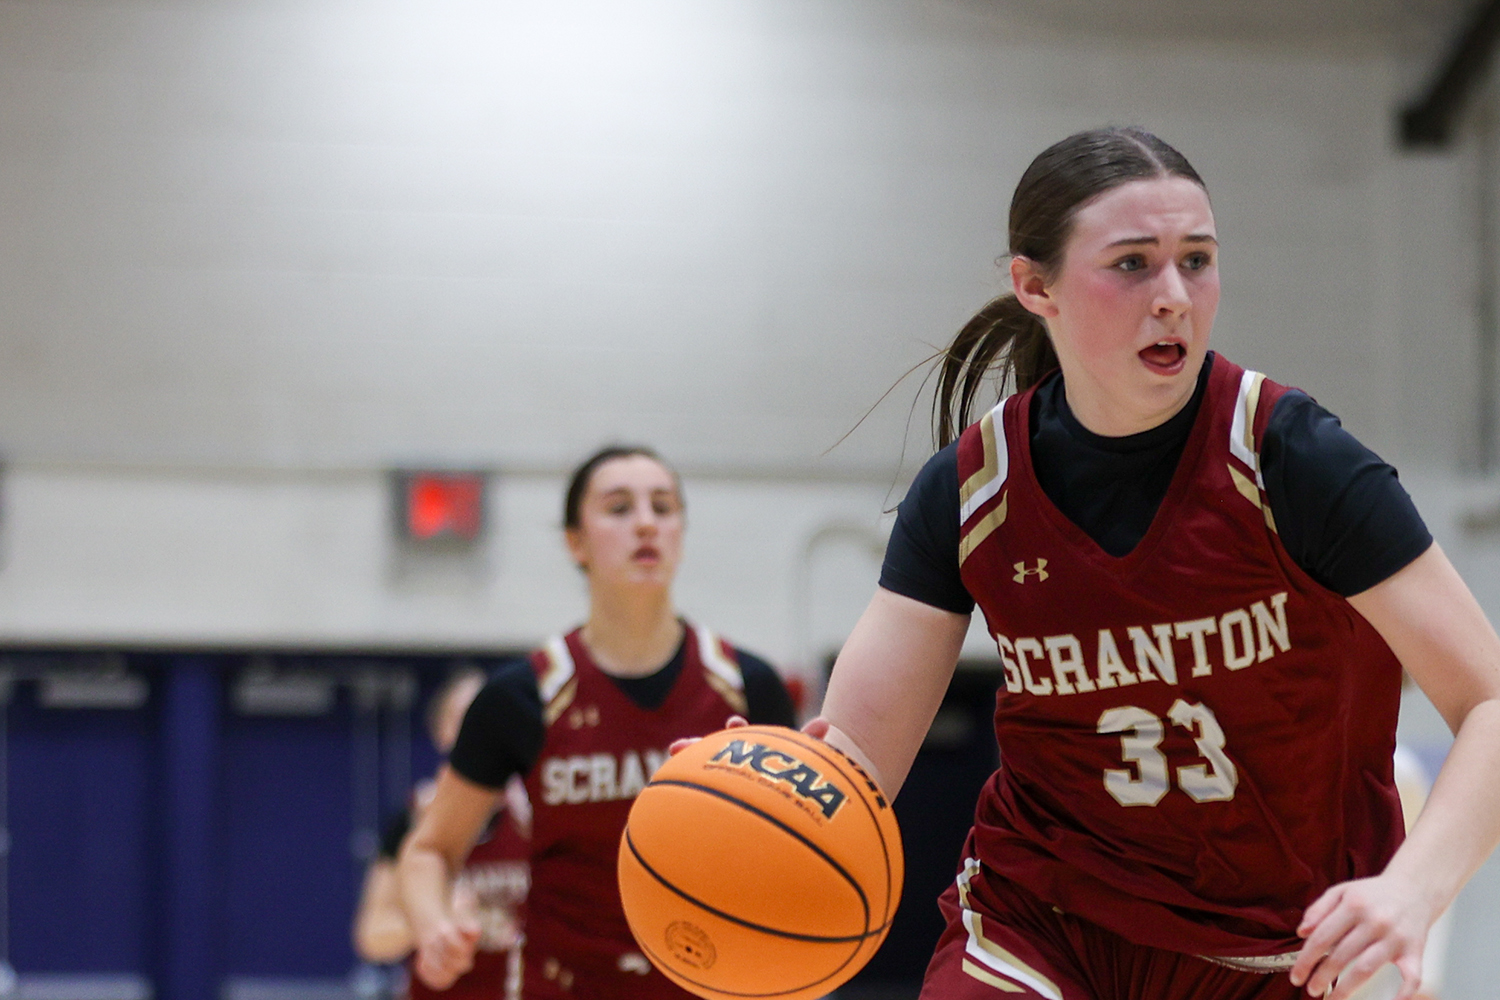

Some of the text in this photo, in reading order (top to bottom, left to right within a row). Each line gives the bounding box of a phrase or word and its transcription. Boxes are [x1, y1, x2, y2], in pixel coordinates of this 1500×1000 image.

[998, 592, 1291, 696] SCRANTON
[704, 738, 850, 822] NCAA
[1097, 698, 1238, 807] 33
